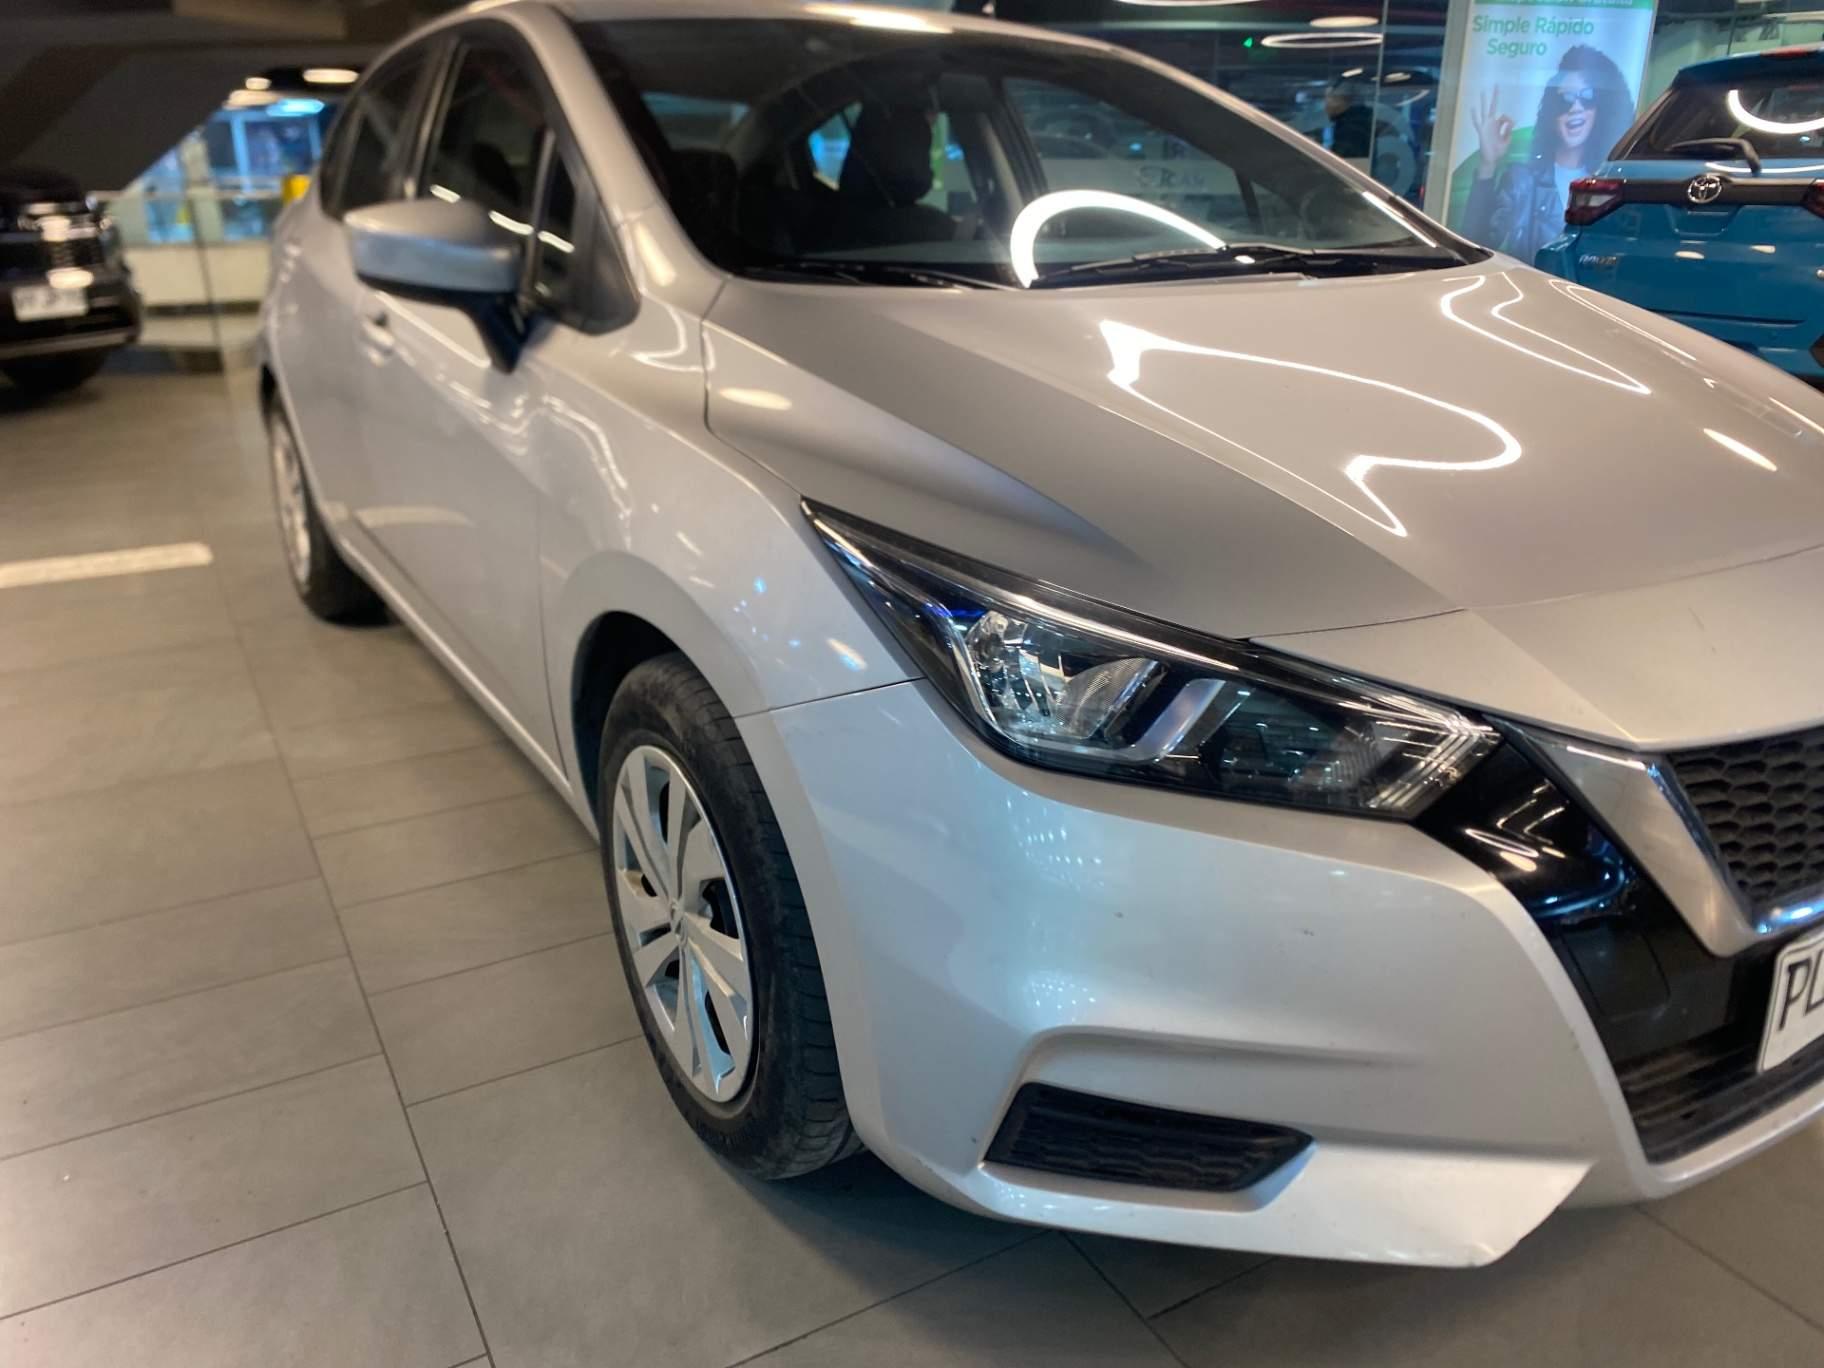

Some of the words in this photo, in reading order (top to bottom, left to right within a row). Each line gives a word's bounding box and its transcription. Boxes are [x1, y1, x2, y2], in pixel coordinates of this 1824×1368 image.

[1472, 15, 1529, 35] Simple
[1535, 15, 1594, 37] Rápido
[1487, 39, 1547, 58] Seguro
